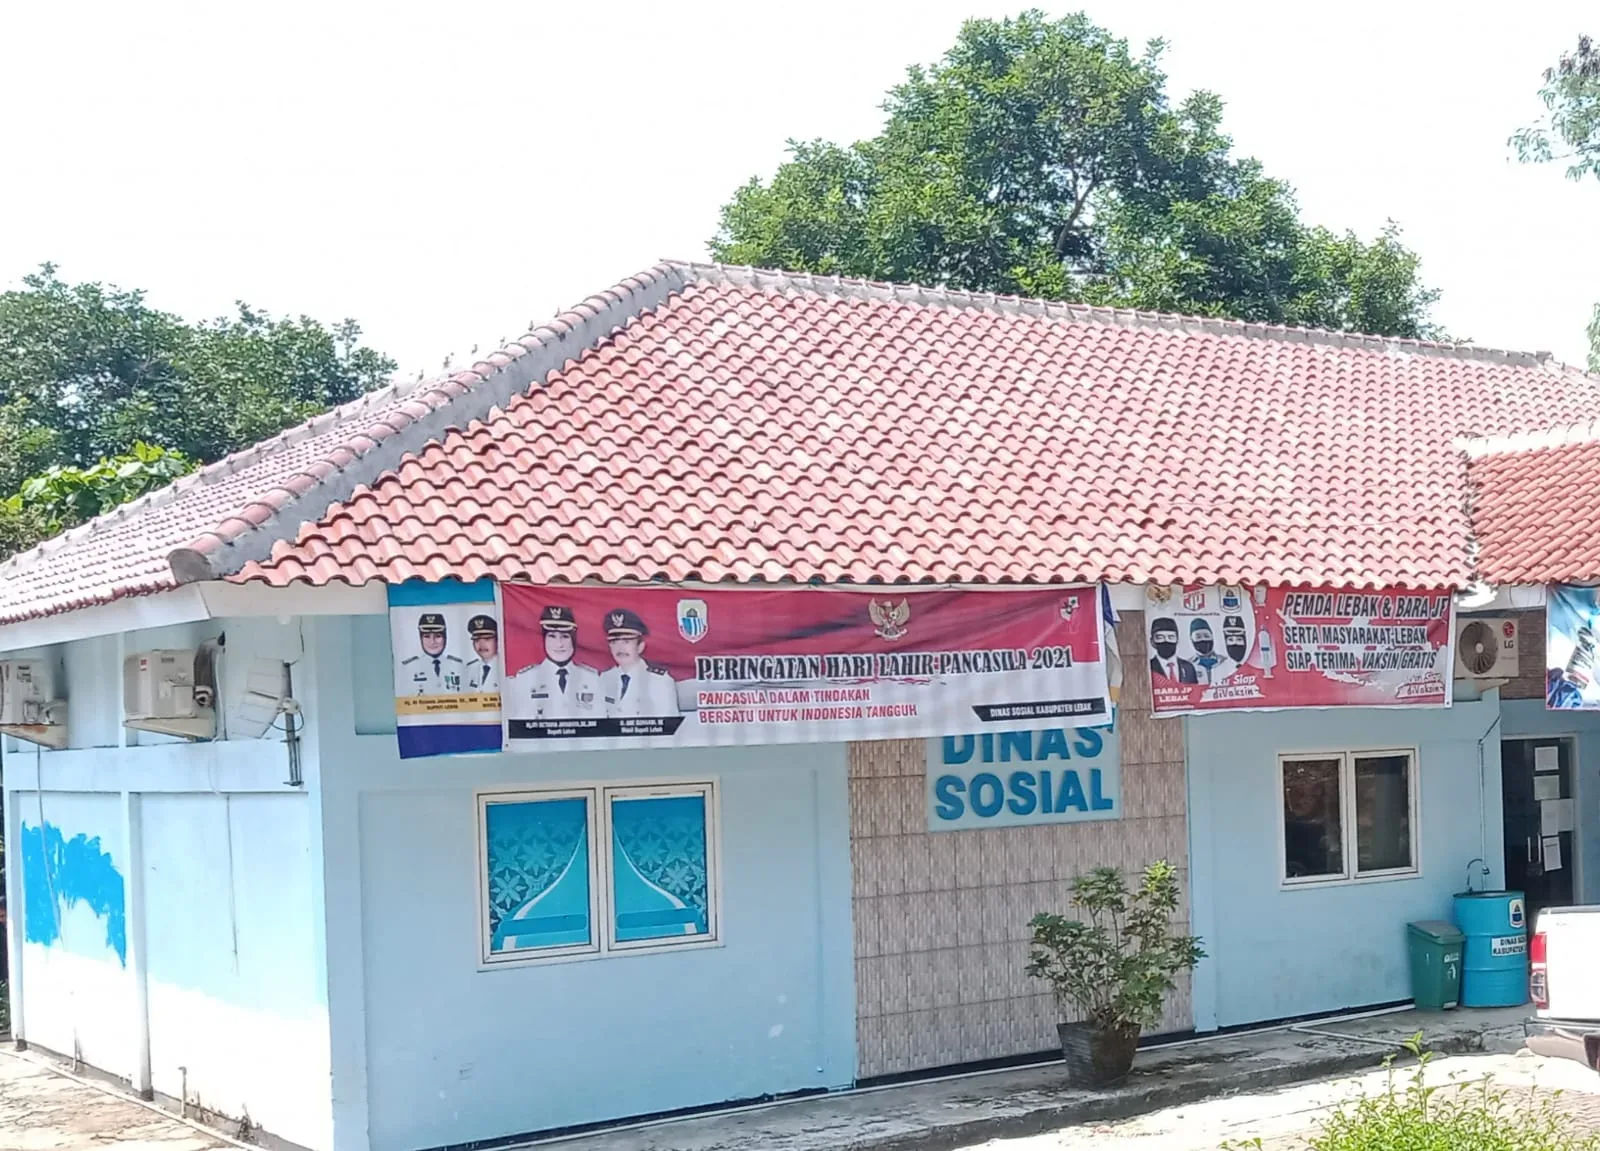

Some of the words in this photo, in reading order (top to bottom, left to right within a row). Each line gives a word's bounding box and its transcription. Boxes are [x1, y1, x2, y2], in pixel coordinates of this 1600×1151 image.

[1283, 594, 1332, 617] PEMDA
[1336, 595, 1379, 617] LEBAK
[1382, 596, 1392, 618] &
[1395, 597, 1429, 618] BARA
[1285, 626, 1319, 645] SERTA
[1322, 627, 1391, 645] MASYARAKAT
[1395, 628, 1427, 645] LEBAK
[1503, 640, 1514, 649] LG
[697, 656, 820, 681] PERINGATAN
[825, 655, 874, 678] HARI
[879, 653, 934, 677] LAHIR
[939, 650, 1027, 675] PANCASILA
[1032, 646, 1073, 670] 2021
[1287, 652, 1311, 670] SIAP
[1315, 652, 1356, 670] TERIMA
[1362, 652, 1400, 670] VAKSIN
[1401, 652, 1437, 669] GRATIS
[699, 692, 767, 705] PANCASILA
[770, 690, 810, 704] DALAM
[814, 689, 870, 702] TINDAKAN
[700, 710, 754, 723] BERSATU
[758, 708, 798, 722] UNTUK
[801, 706, 863, 721] INDONESIA
[867, 704, 917, 718] TANGGUH
[990, 708, 1011, 717] DINAS
[1012, 706, 1035, 716] SOSIAL
[1036, 704, 1073, 714] KABUPATEN
[1074, 702, 1092, 712] LEBAK
[943, 727, 1104, 764] DINAS
[935, 768, 1113, 820] SOSIAL
